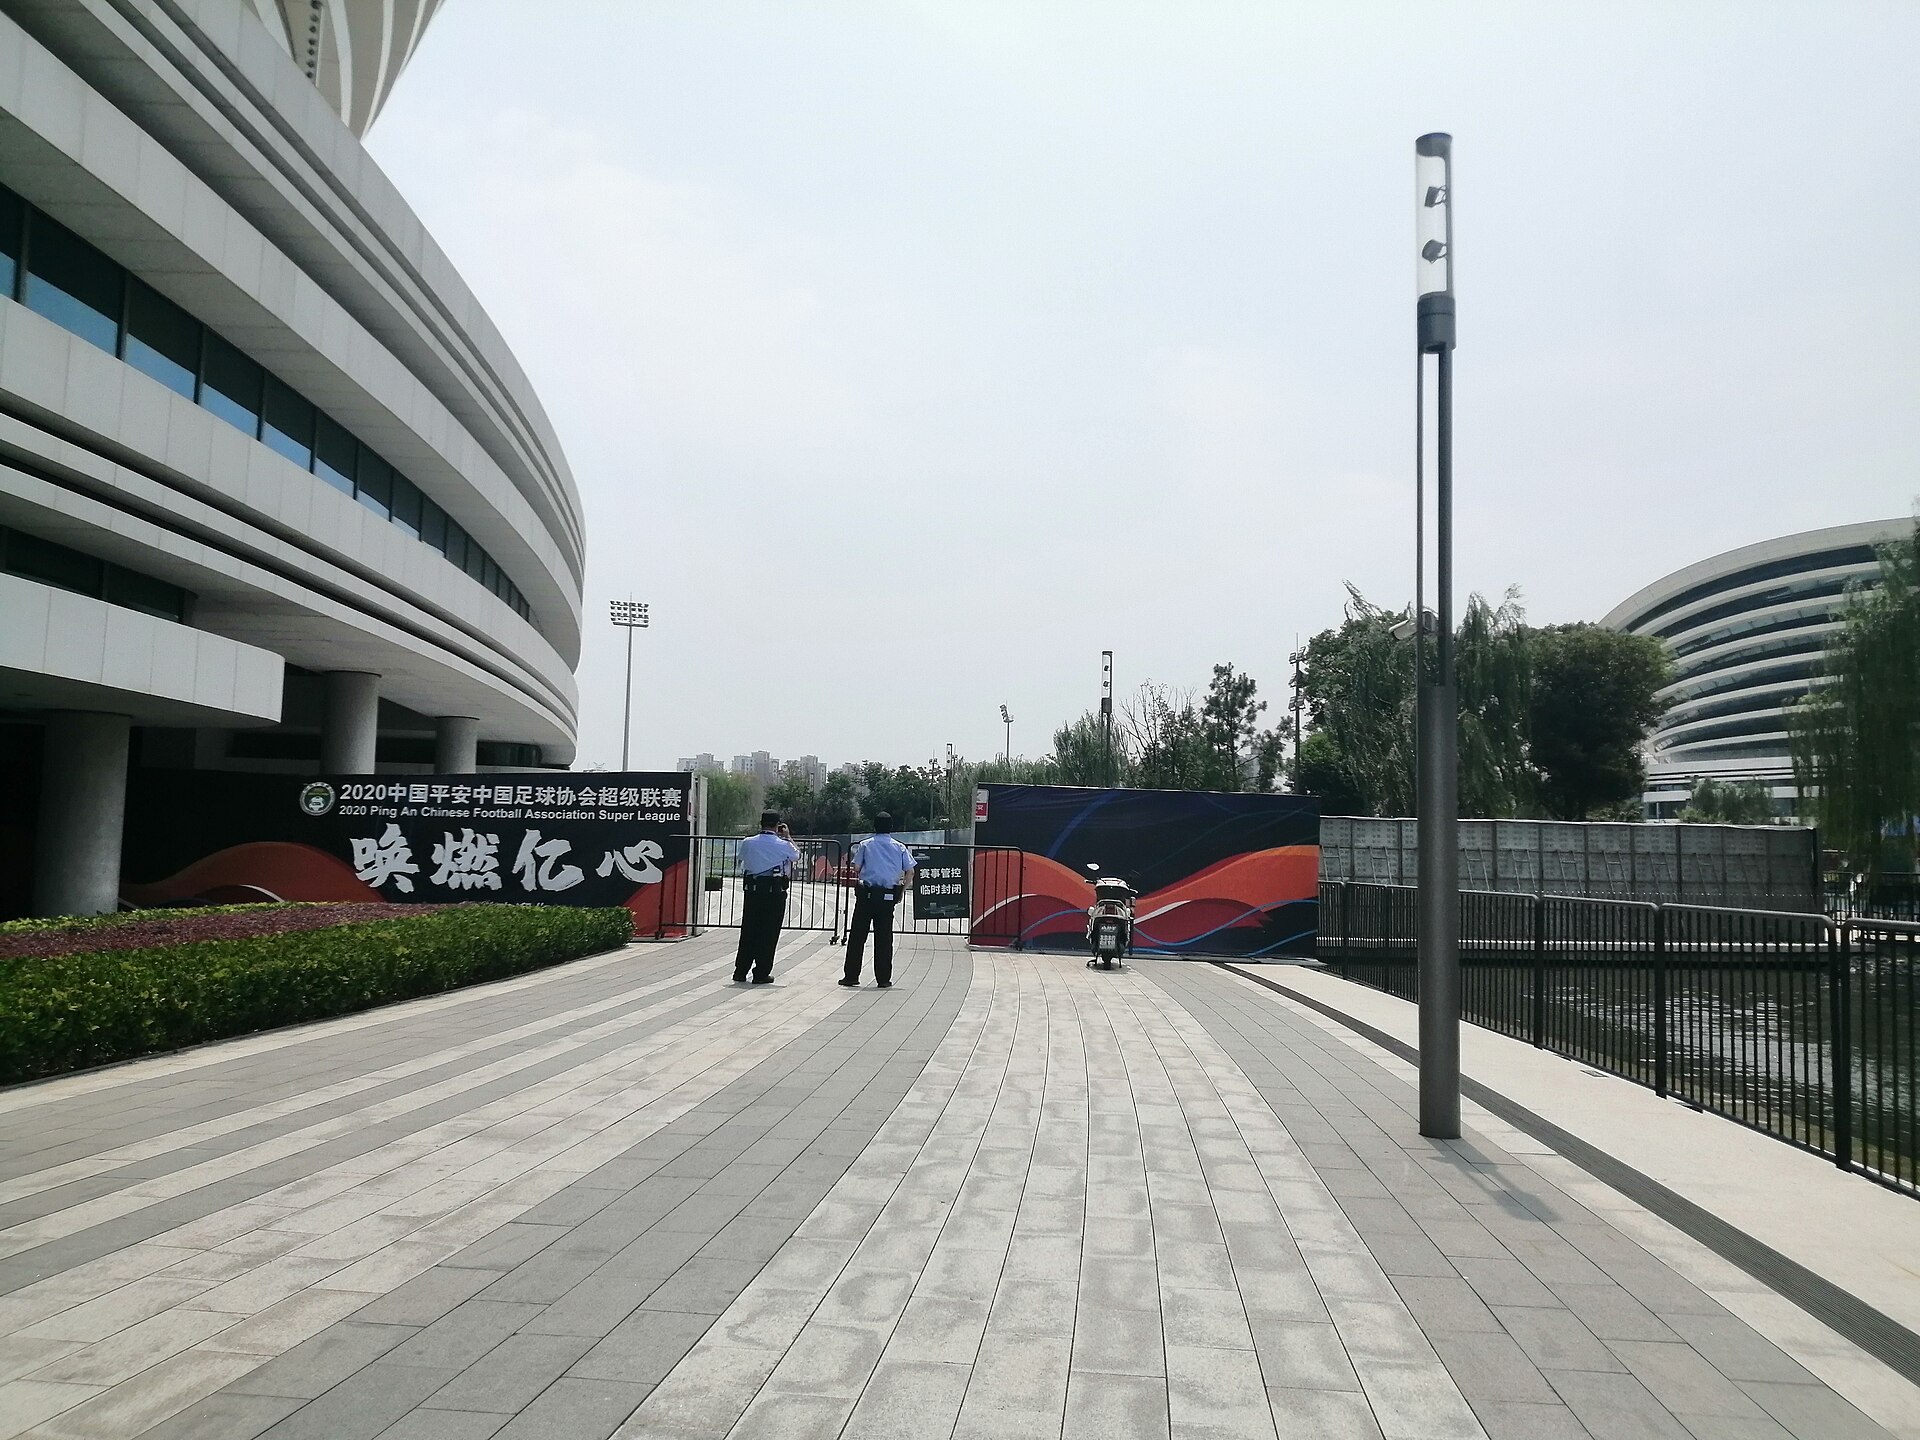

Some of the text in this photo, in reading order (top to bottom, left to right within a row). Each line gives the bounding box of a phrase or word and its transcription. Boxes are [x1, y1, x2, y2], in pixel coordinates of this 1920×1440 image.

[340, 783, 682, 808] 2020中国平安中国足球协会超级联赛
[339, 806, 681, 823] 2020 Ping An Chinese Football Association Super League
[349, 823, 664, 894] 唤燃亿心
[919, 867, 962, 879] 赛事管控
[920, 883, 962, 895] 临时封闭
